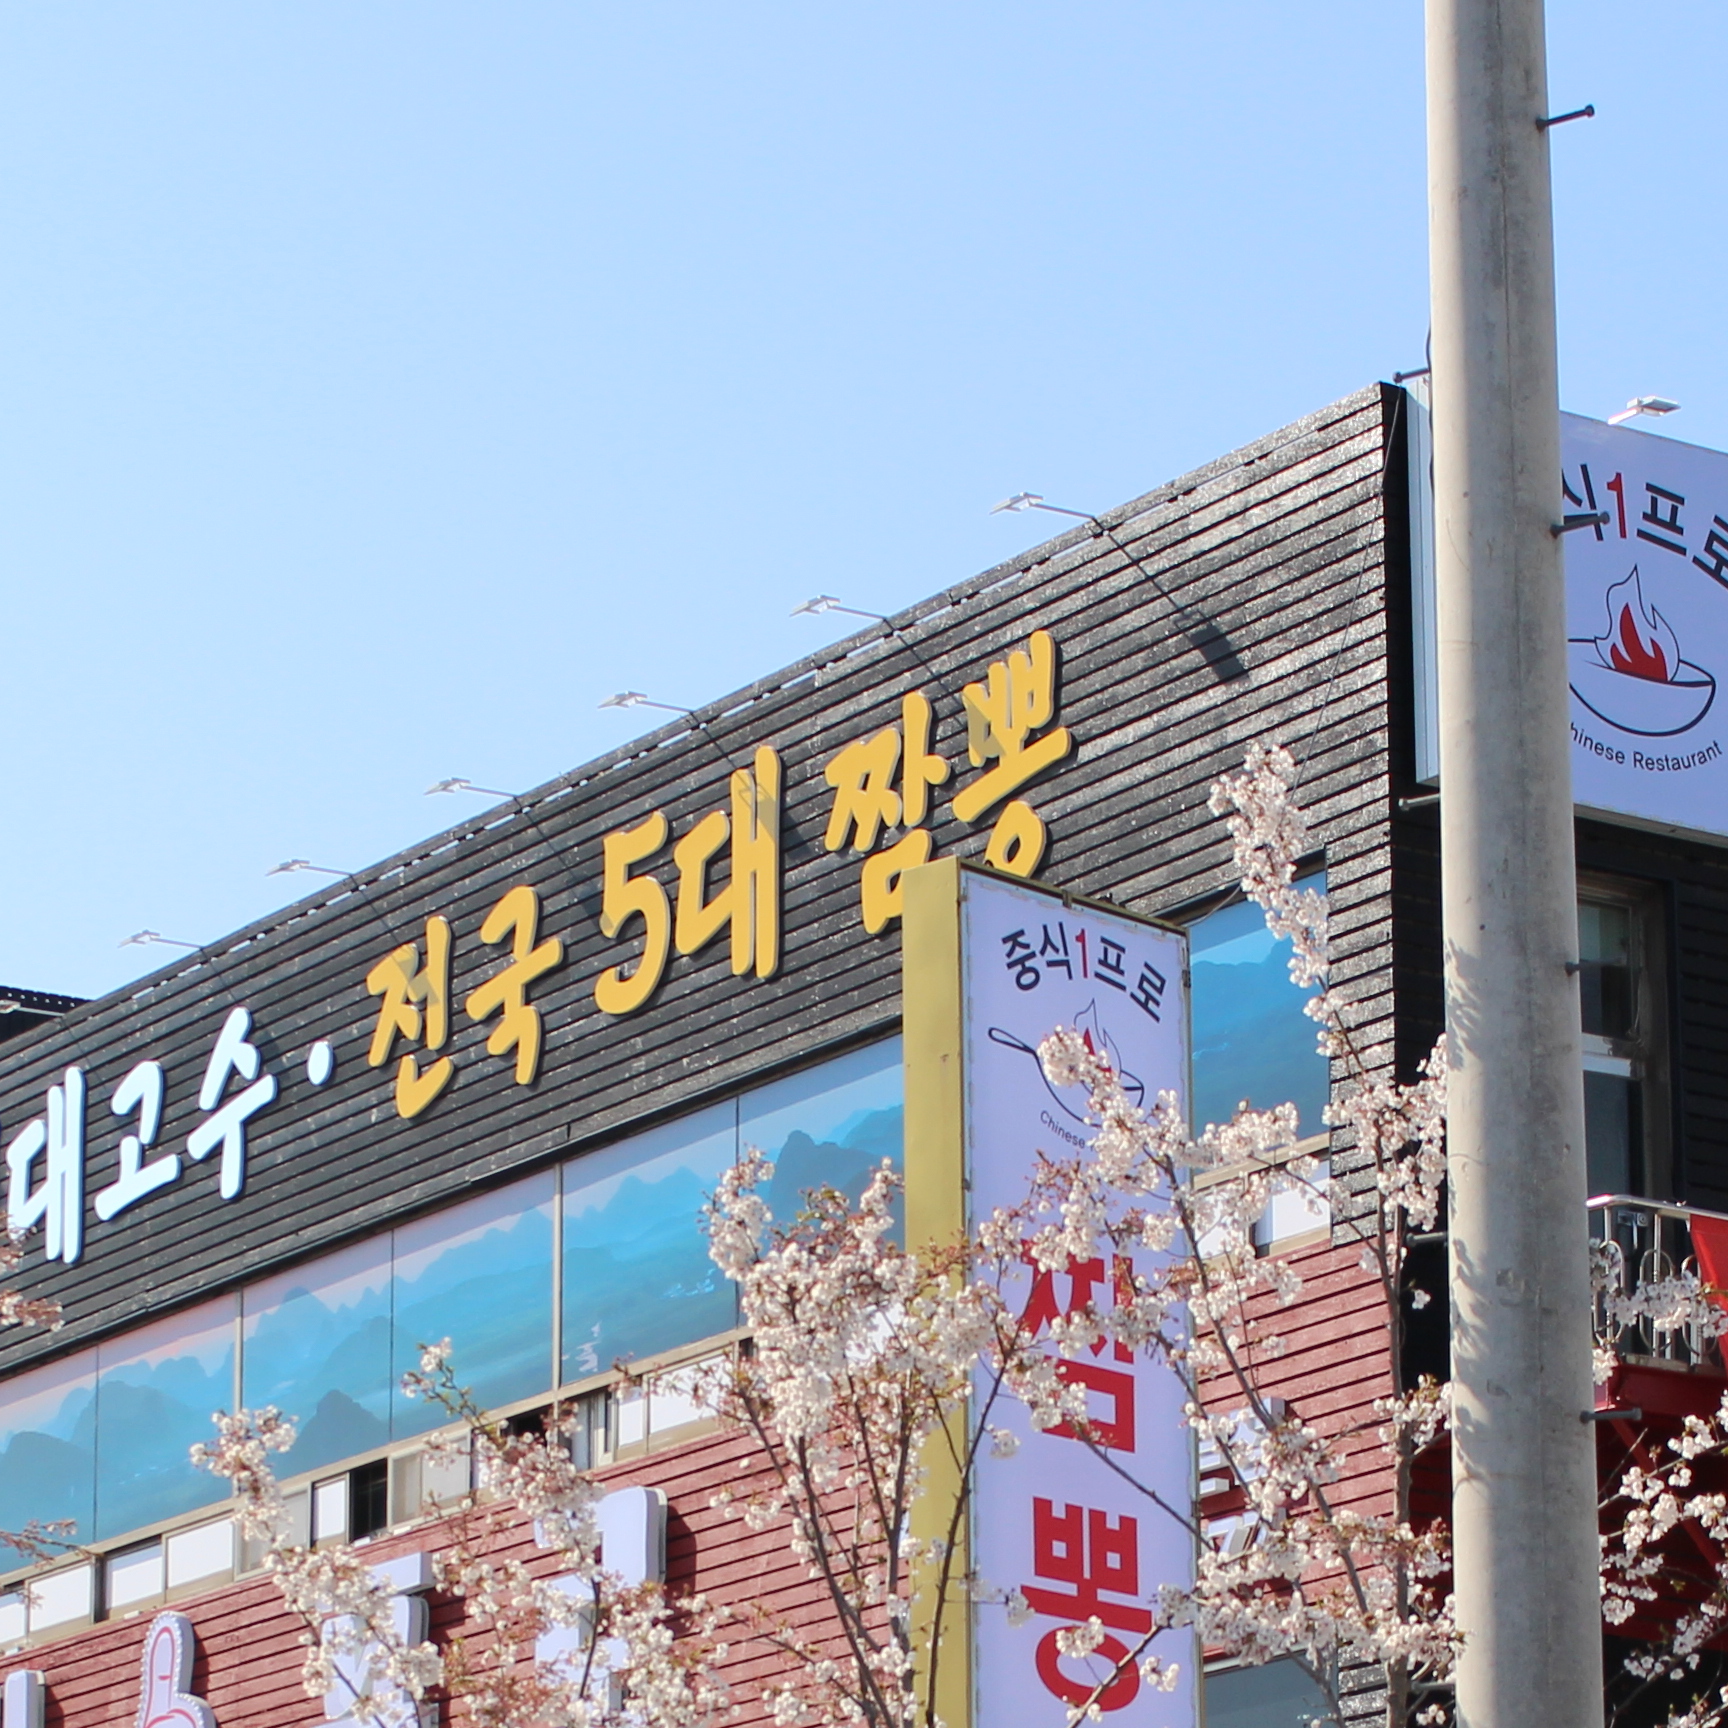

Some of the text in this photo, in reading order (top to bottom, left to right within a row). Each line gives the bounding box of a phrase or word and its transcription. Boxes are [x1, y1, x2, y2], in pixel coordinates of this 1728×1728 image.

[1570, 722, 1723, 772] hinese Restaurant
[366, 884, 562, 1119] 전국
[595, 744, 780, 1015] 5대
[823, 630, 1071, 936] 짬뽕
[1001, 921, 1168, 1023] 중식1프로
[1040, 1110, 1087, 1149] Chinese
